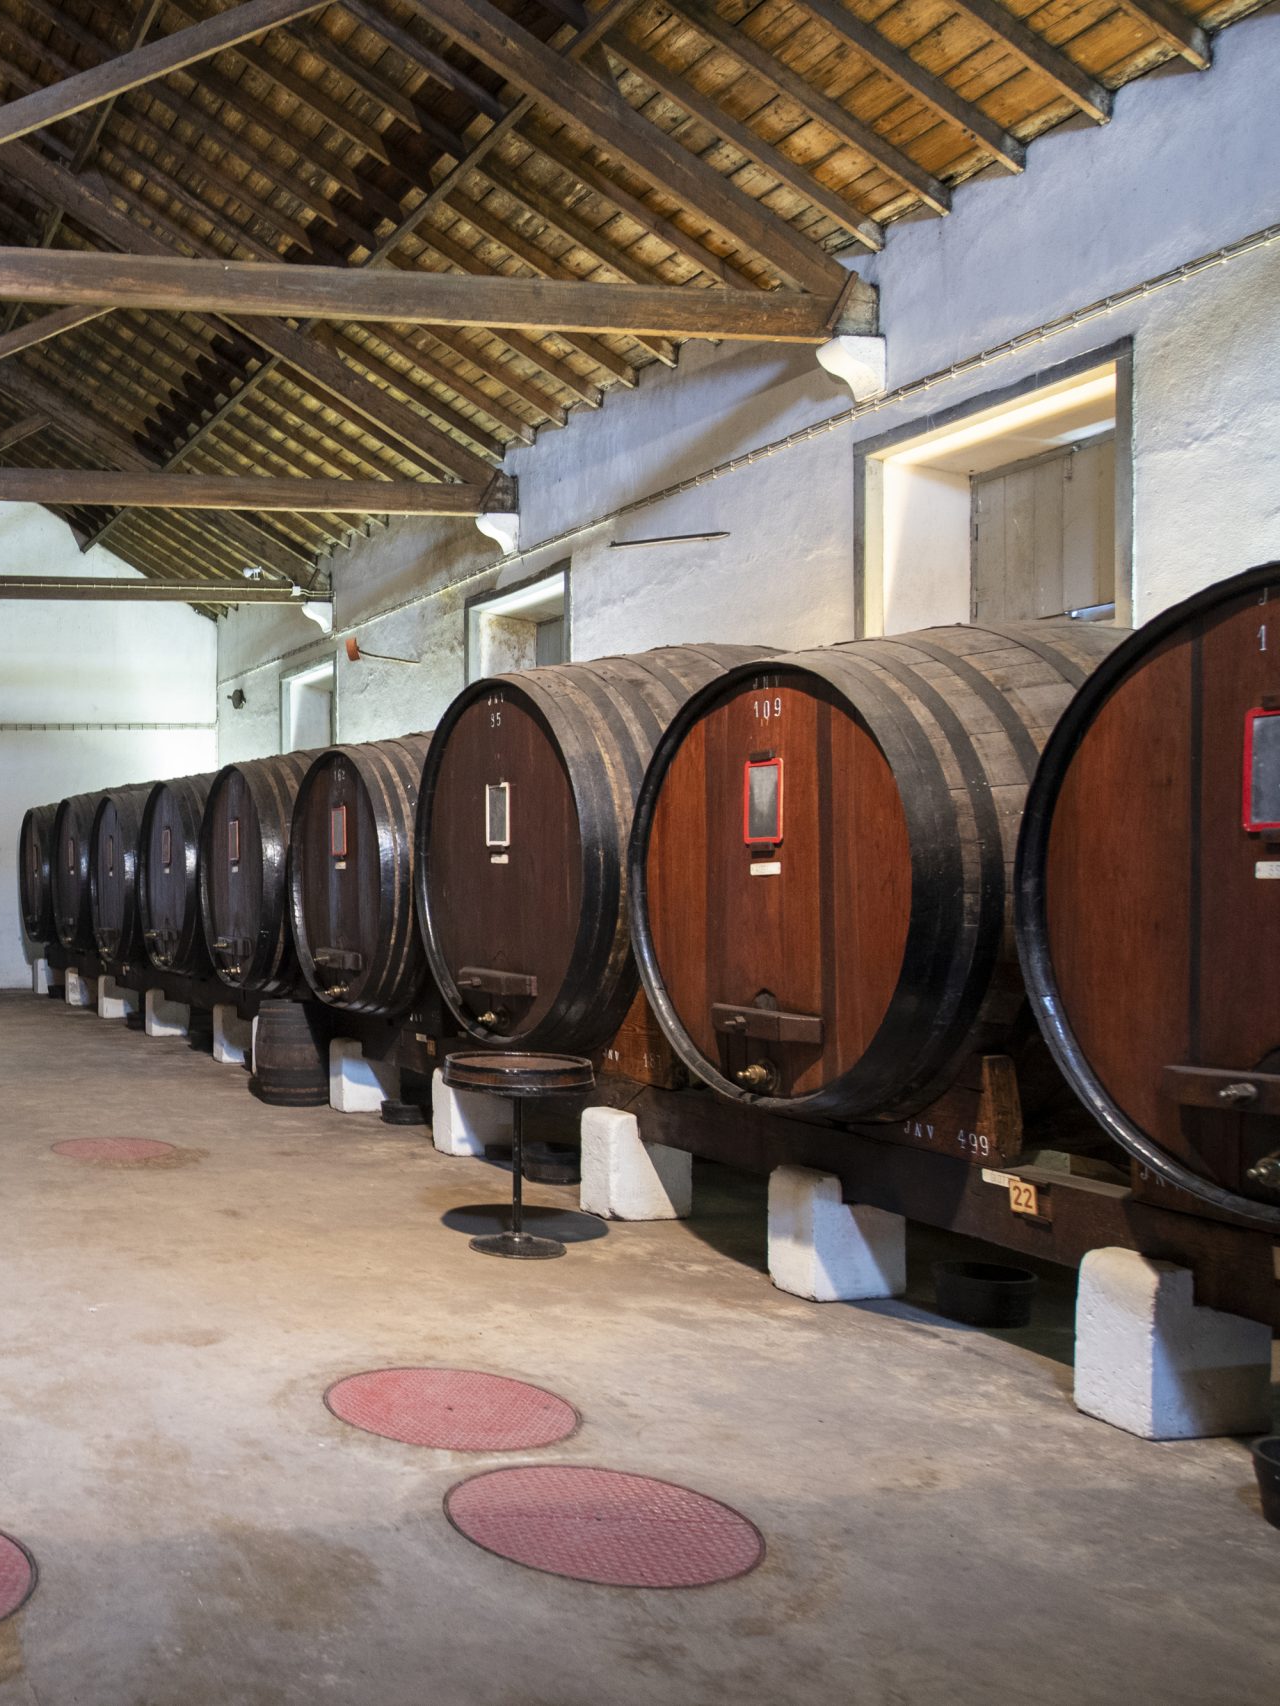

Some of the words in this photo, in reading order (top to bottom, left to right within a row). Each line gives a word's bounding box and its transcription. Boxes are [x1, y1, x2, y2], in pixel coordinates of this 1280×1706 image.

[753, 697, 782, 720] 109
[904, 1120, 934, 1140] JNV
[957, 1128, 990, 1156] 499
[1012, 1185, 1033, 1209] 22
